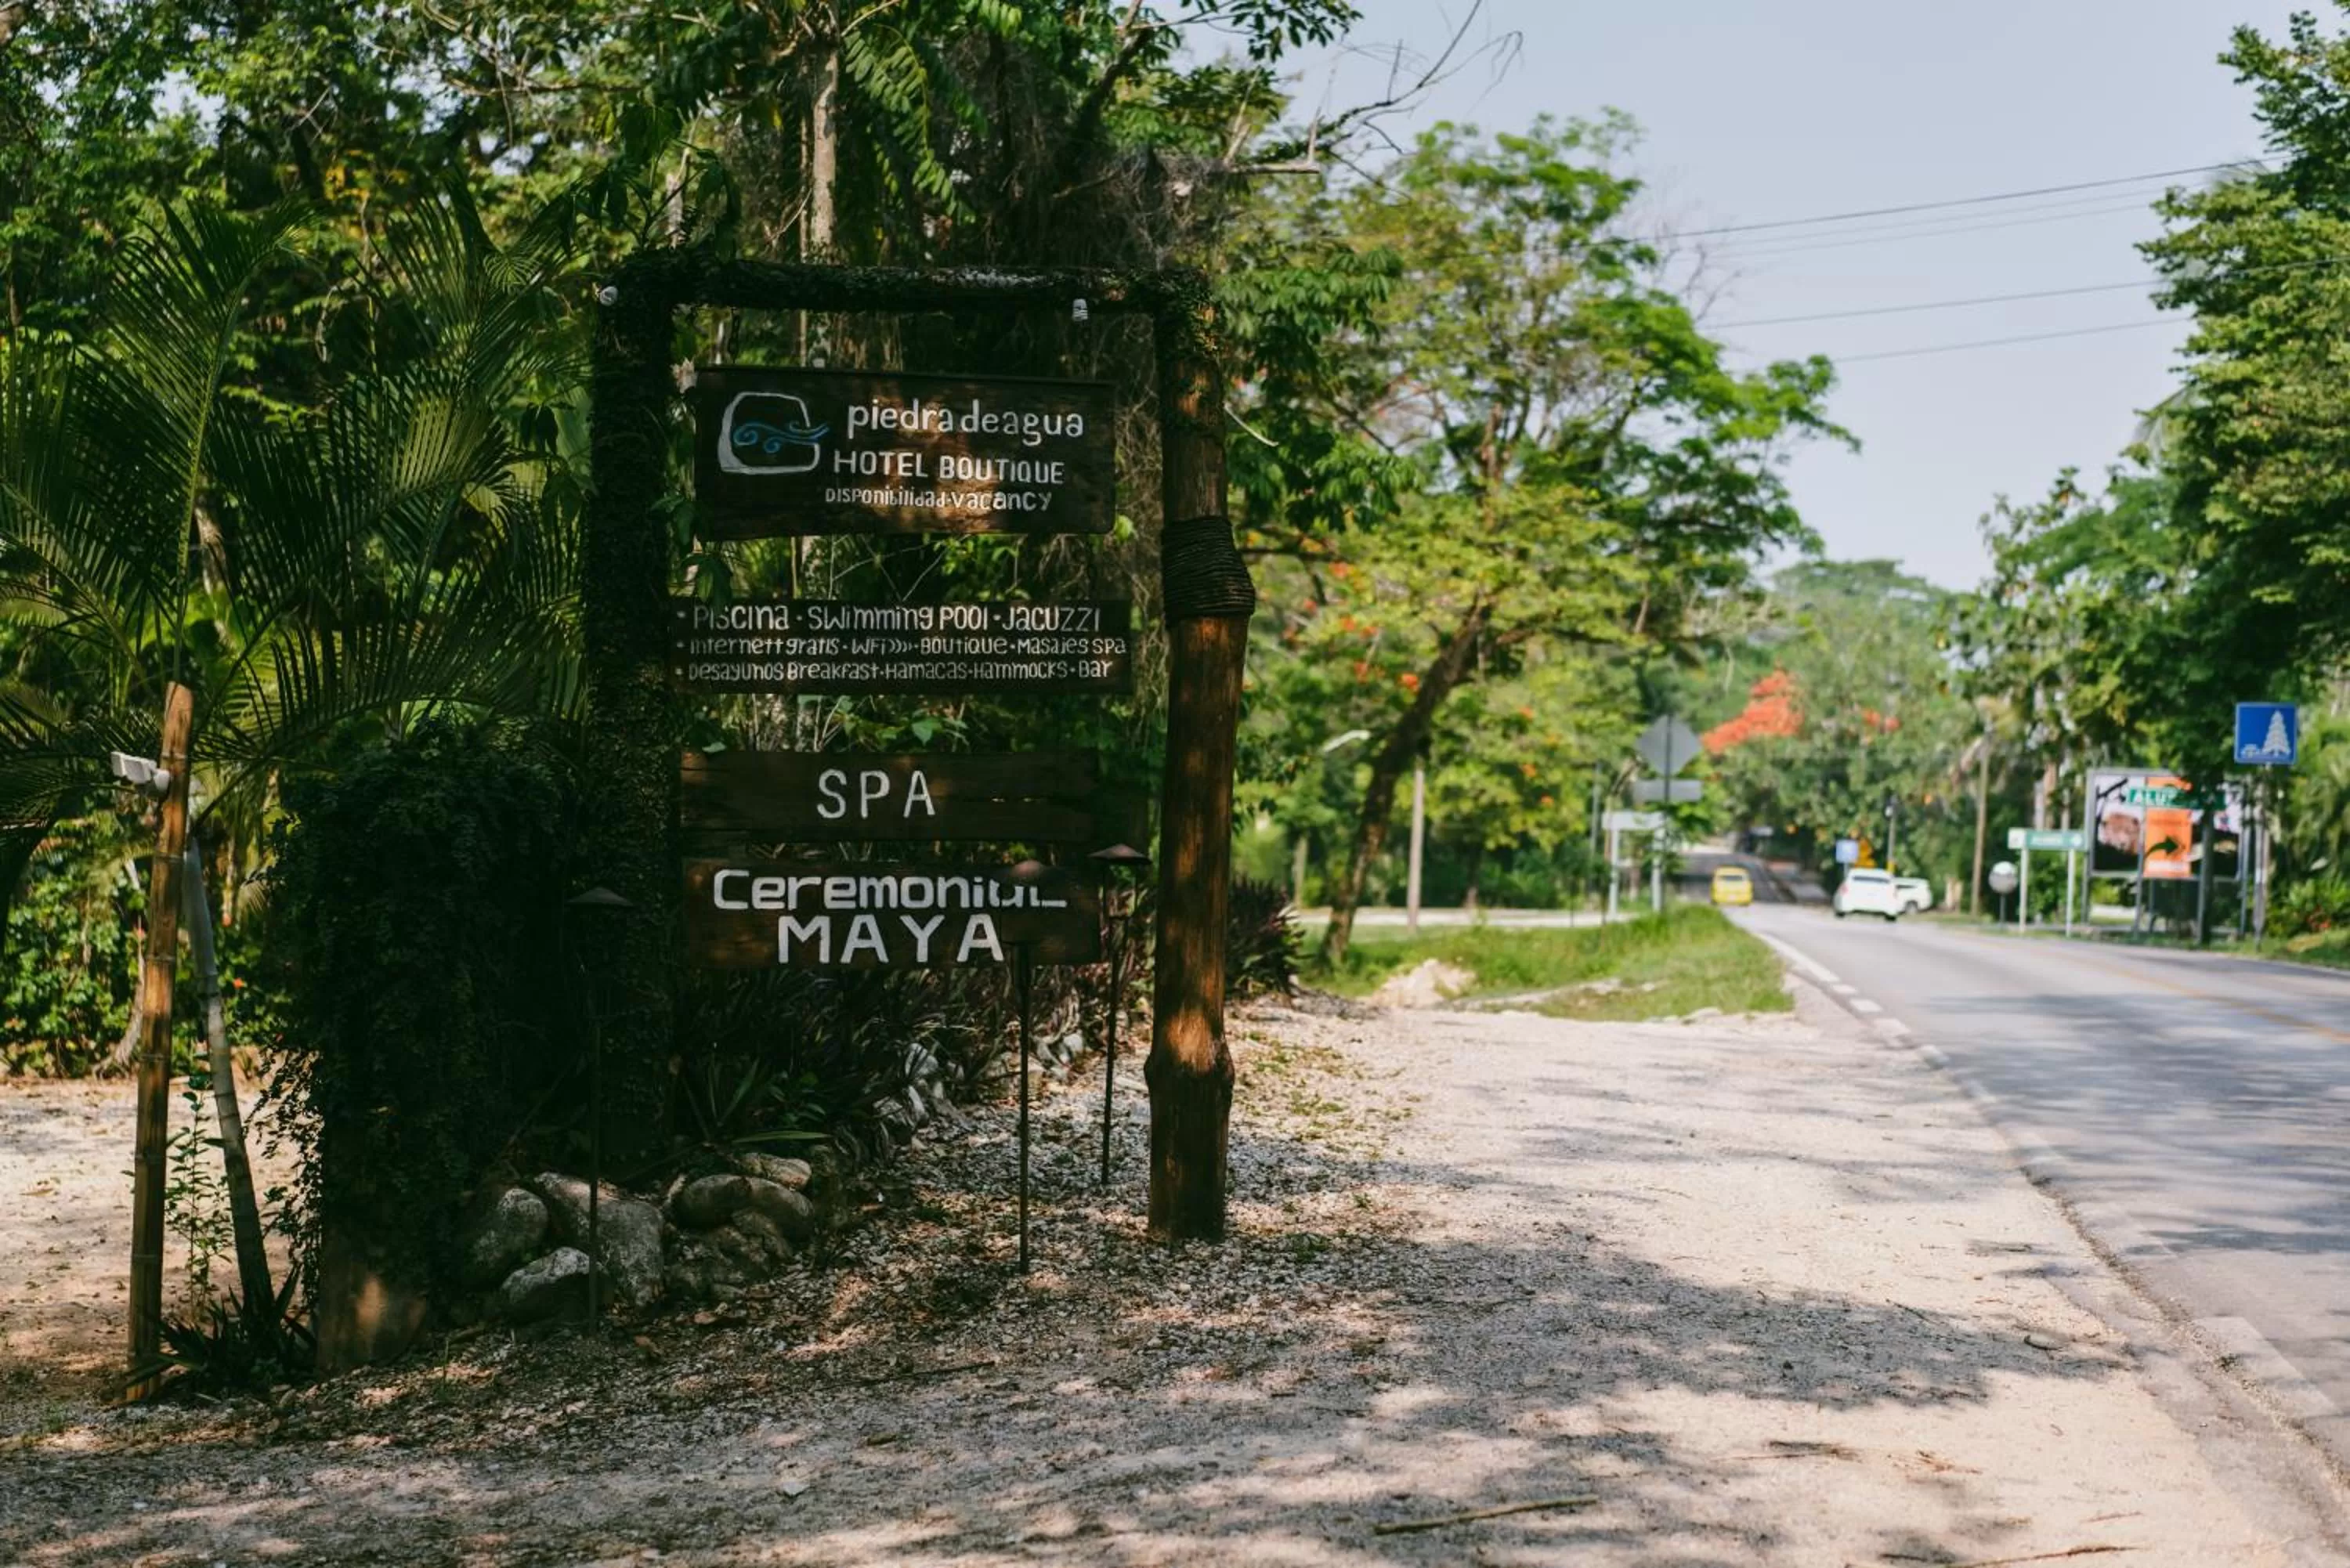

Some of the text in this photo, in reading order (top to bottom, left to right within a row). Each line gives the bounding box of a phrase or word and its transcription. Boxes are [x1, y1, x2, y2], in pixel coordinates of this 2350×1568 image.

[847, 398, 954, 439] piedra
[833, 450, 1065, 485] HOTEL BOUTIQUE
[1079, 659, 1113, 678] Bar
[816, 768, 936, 819] SPA
[778, 913, 1004, 964] MAYA
